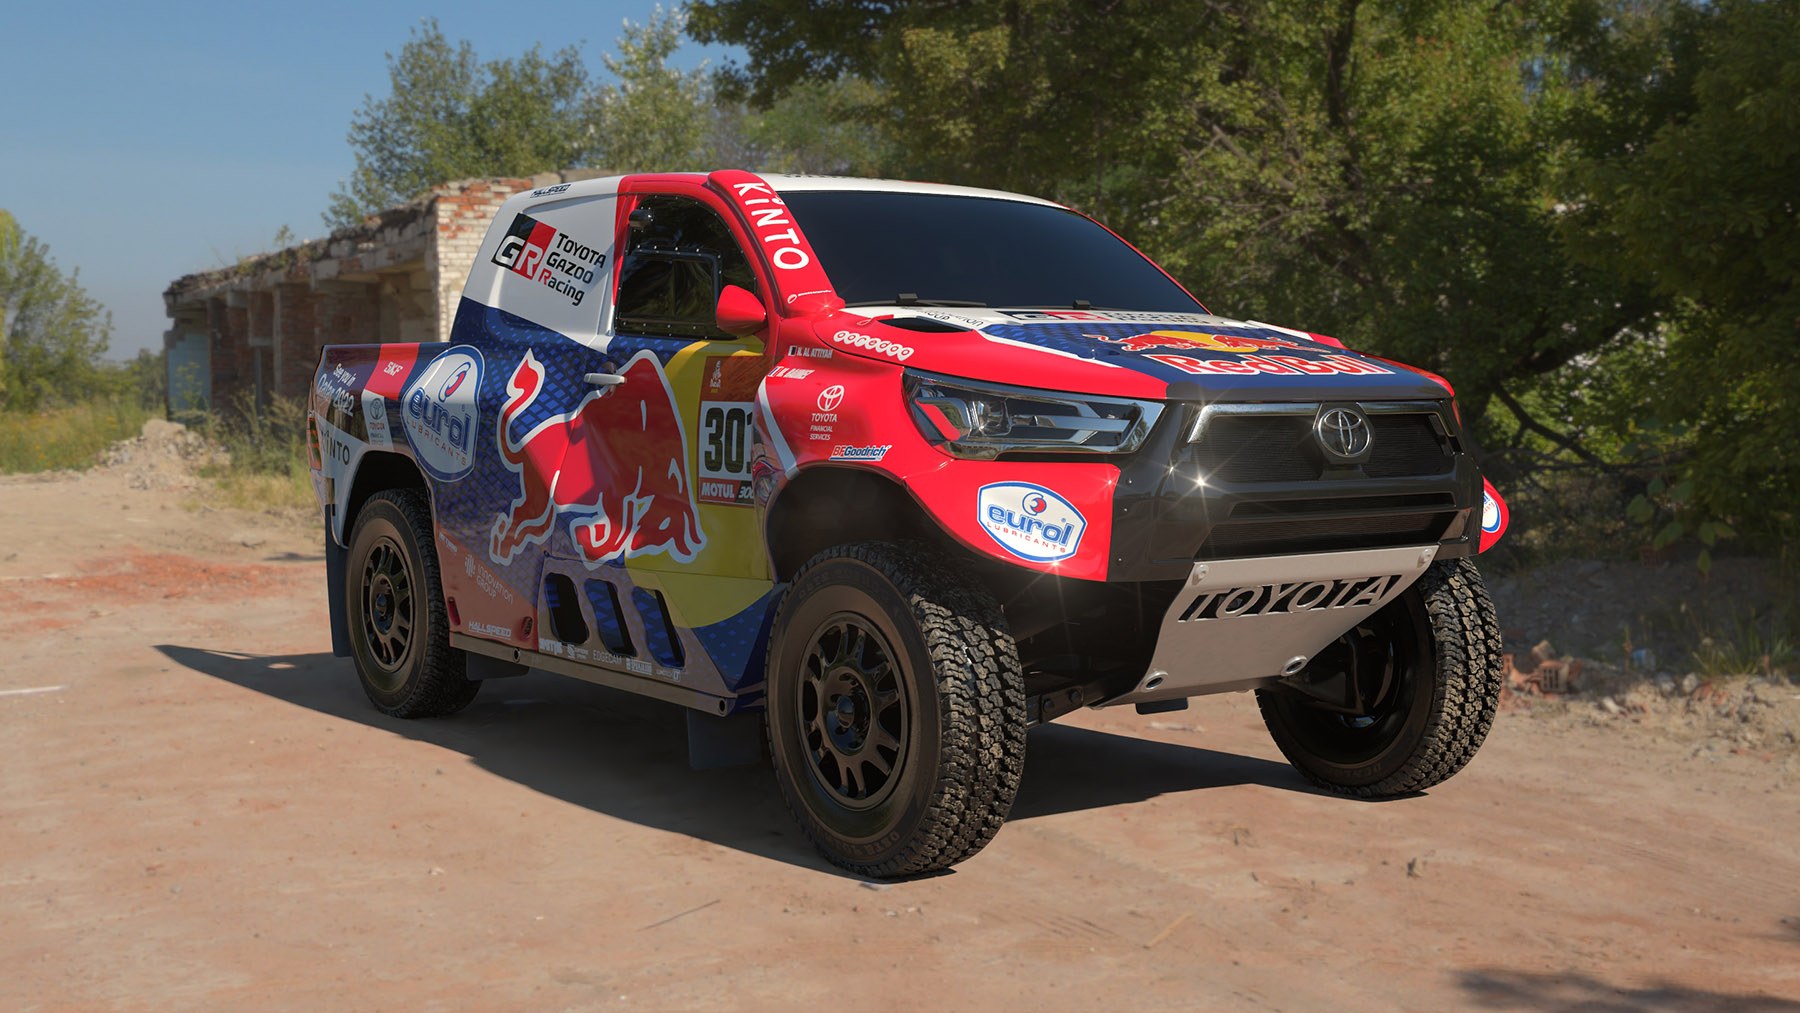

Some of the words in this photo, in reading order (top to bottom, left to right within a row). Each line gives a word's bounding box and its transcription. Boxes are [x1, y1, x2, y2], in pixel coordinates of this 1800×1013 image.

[494, 235, 544, 277] GR
[546, 251, 594, 284] GAZOO
[556, 232, 607, 269] TOYOTA
[537, 268, 585, 307] Racing
[383, 361, 403, 377] SKF
[1141, 354, 1304, 375] Red
[1259, 354, 1397, 376] Bull
[409, 387, 471, 455] eurol
[811, 413, 838, 423] TOYOTA
[406, 416, 467, 466] LUBRICANTS
[832, 445, 889, 457] BFGoodrich
[701, 482, 735, 499] MOTUL
[986, 521, 1066, 554] LUBRICANTS
[987, 504, 1075, 546] eurol
[1178, 574, 1402, 623] TOYOTA
